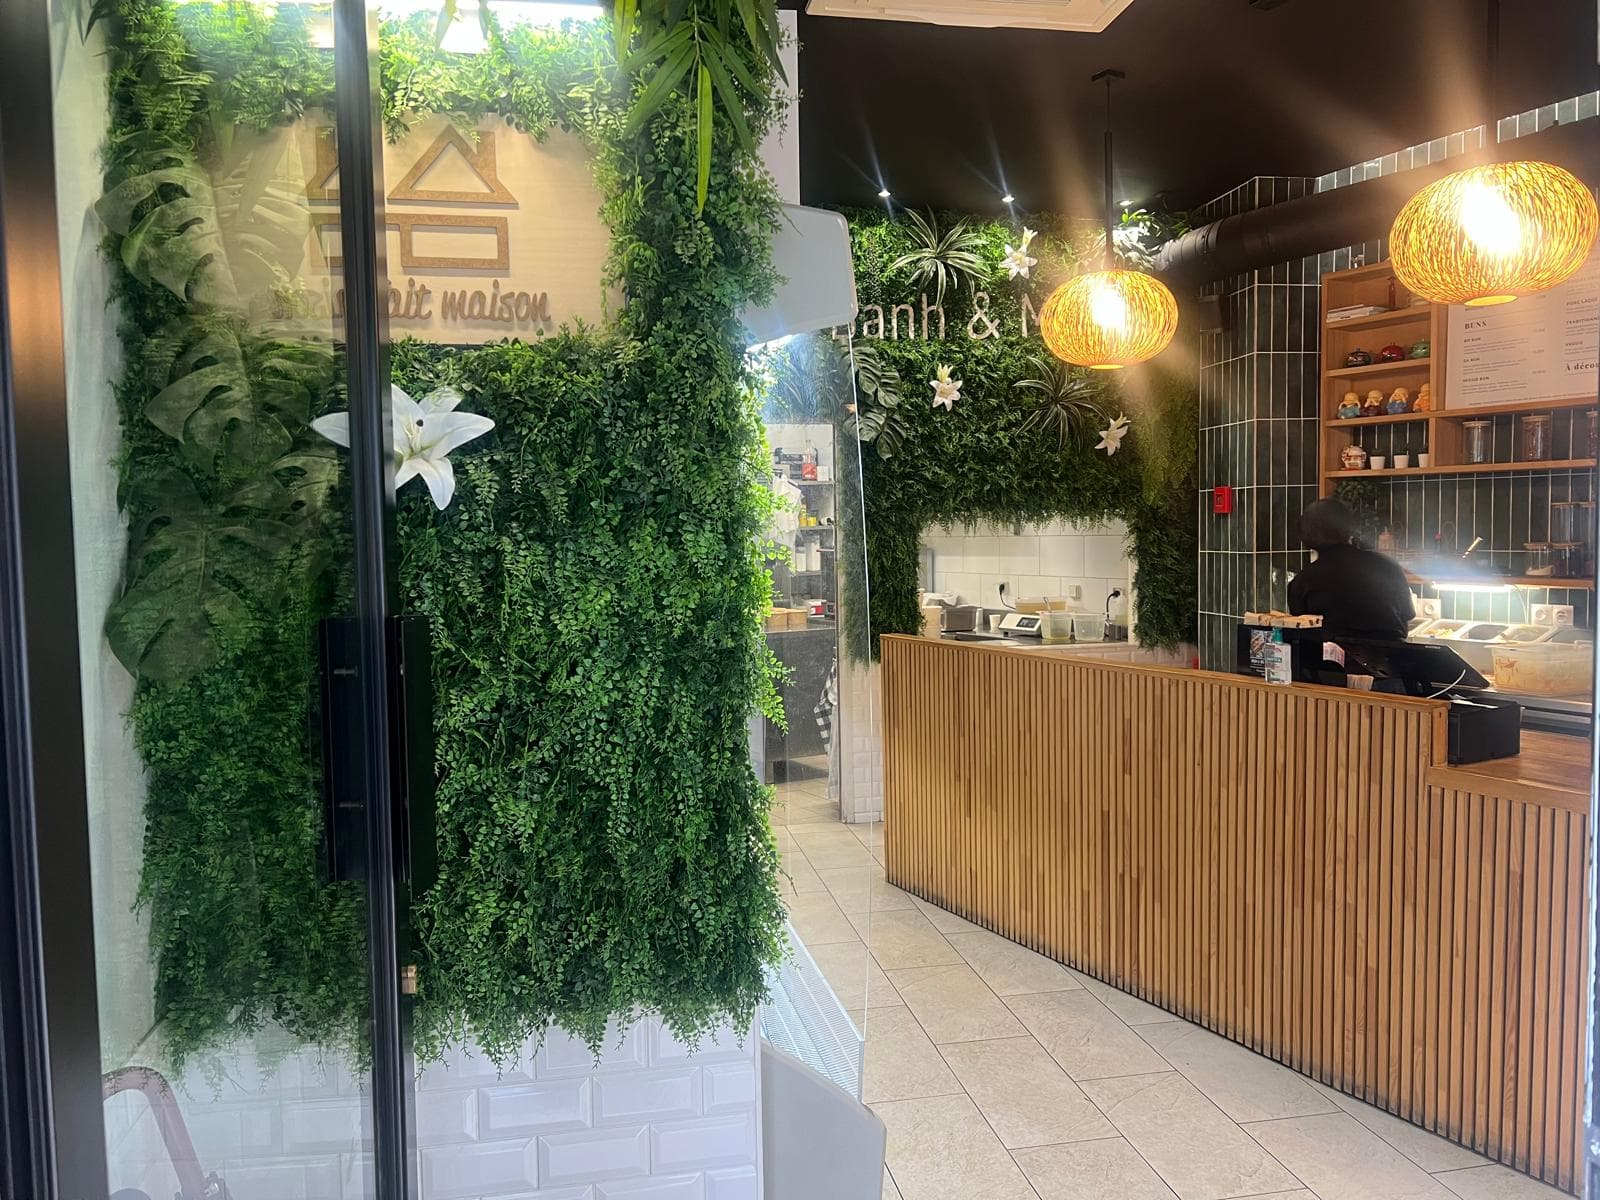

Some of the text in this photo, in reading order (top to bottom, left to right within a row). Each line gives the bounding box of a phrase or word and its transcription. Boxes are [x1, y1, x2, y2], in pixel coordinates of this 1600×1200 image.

[386, 277, 432, 320] ait
[442, 279, 551, 322] maison
[967, 291, 1001, 340] &
